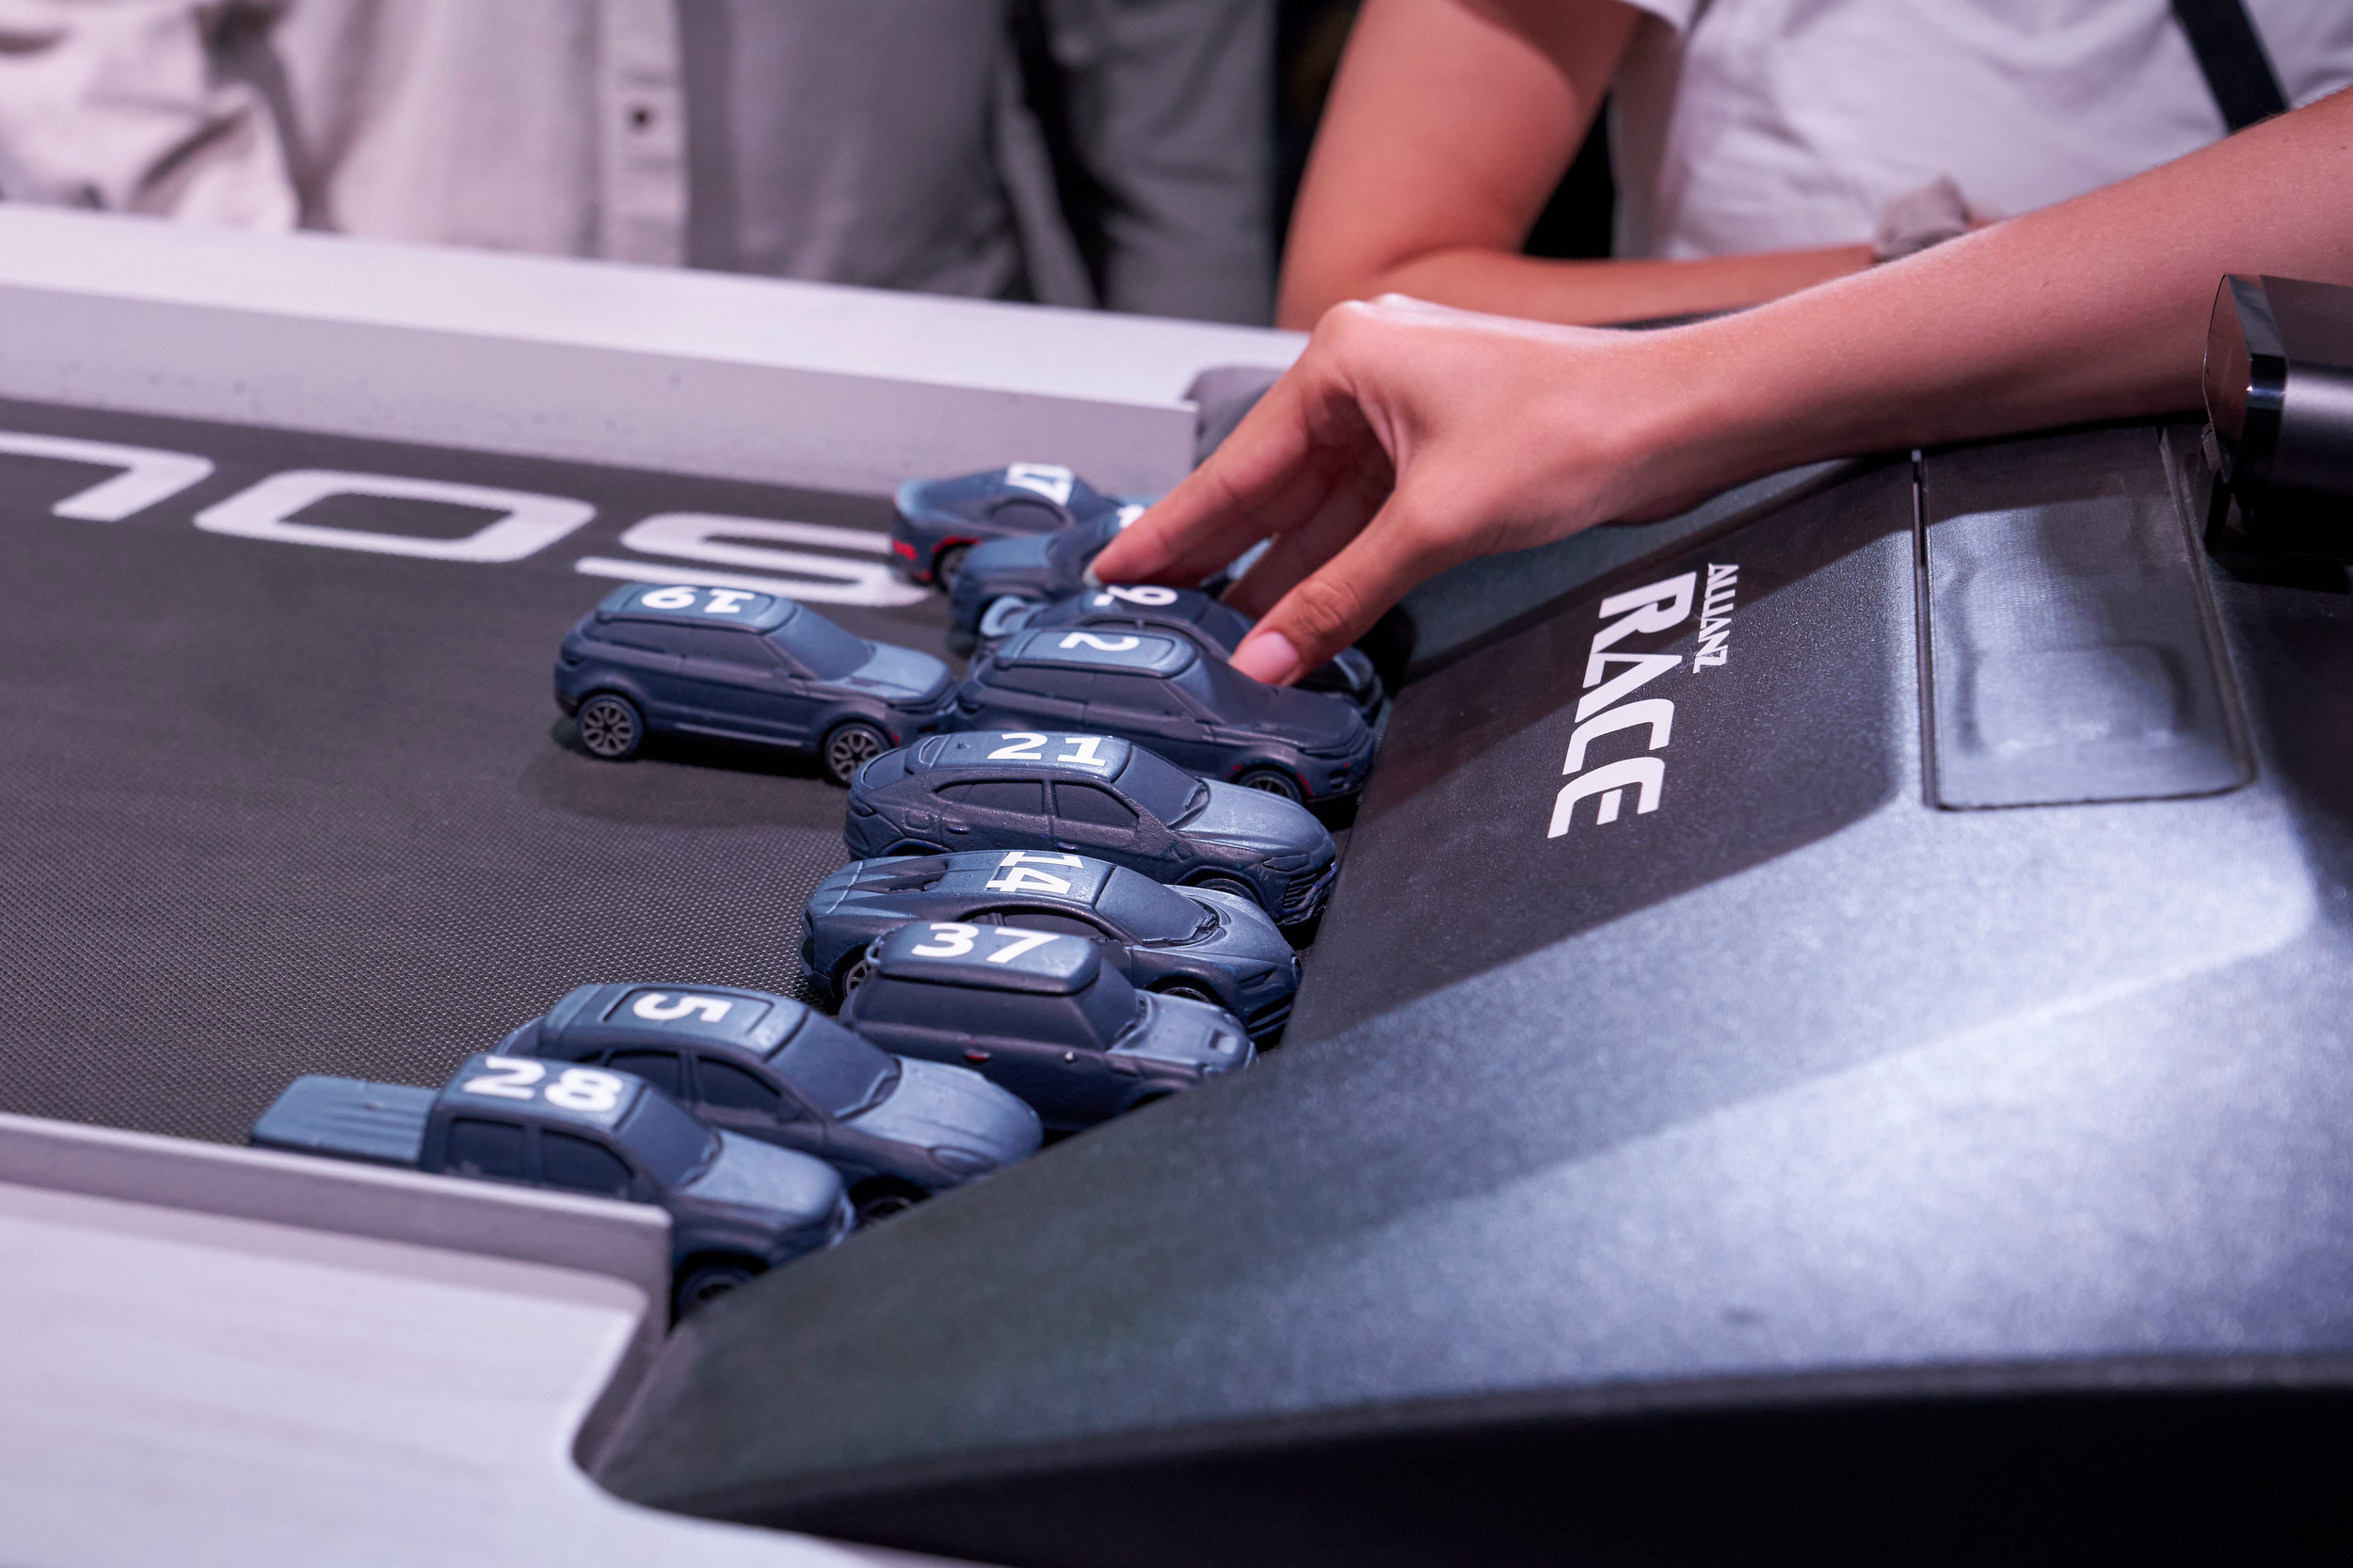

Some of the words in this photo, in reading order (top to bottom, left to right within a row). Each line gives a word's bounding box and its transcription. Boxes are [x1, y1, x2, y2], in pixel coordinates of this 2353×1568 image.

[1693, 563, 1739, 674] ALLIANZ
[1058, 632, 1141, 651] 2
[1547, 571, 1697, 839] RACE
[986, 732, 1106, 767] 21
[984, 851, 1083, 893] 14
[910, 922, 1061, 964] 37
[632, 993, 733, 1023] 5
[462, 1056, 624, 1112] 28
